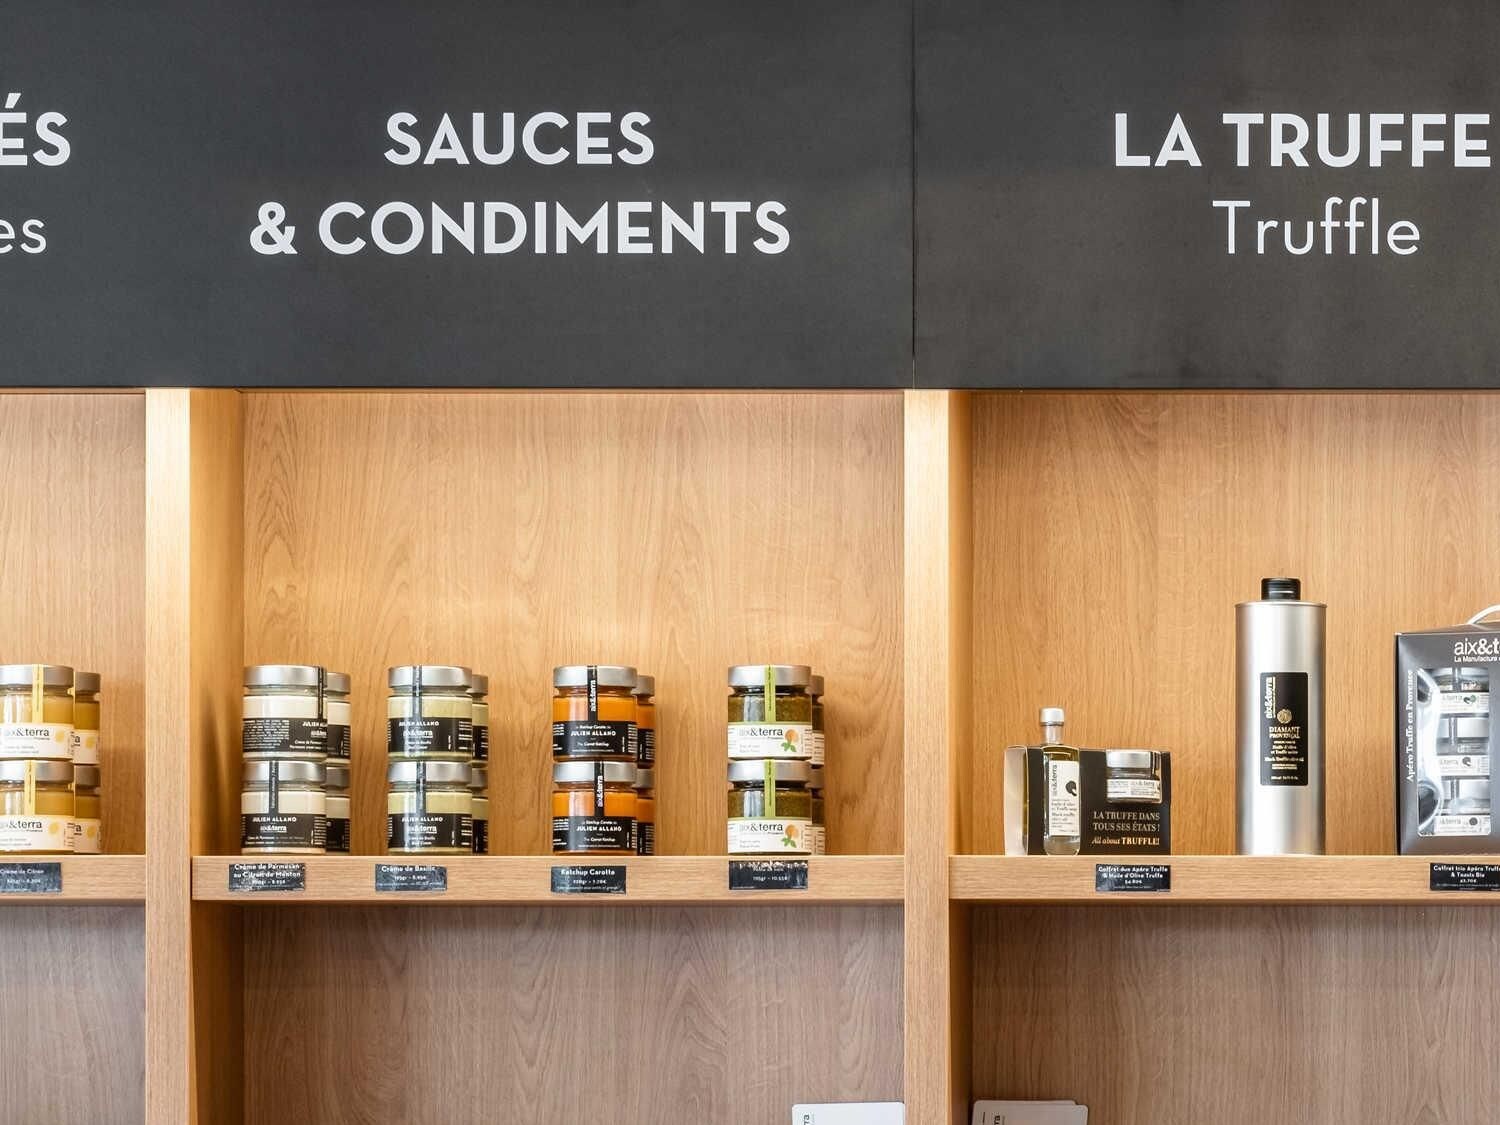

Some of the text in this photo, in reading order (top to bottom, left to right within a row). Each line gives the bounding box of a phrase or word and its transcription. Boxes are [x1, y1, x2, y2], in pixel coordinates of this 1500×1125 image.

[384, 111, 655, 166] SAUCES
[1114, 112, 1491, 168] LA TRUFFE
[249, 200, 790, 255] & CONDIMENTS
[1212, 196, 1421, 256] Truffle
[1092, 837, 1103, 845] All
[1093, 823, 1114, 831] TOUS
[1116, 823, 1131, 831] SES
[1132, 821, 1155, 831] ÉTATS
[1094, 811, 1160, 819] LA TRUFFE DANS
